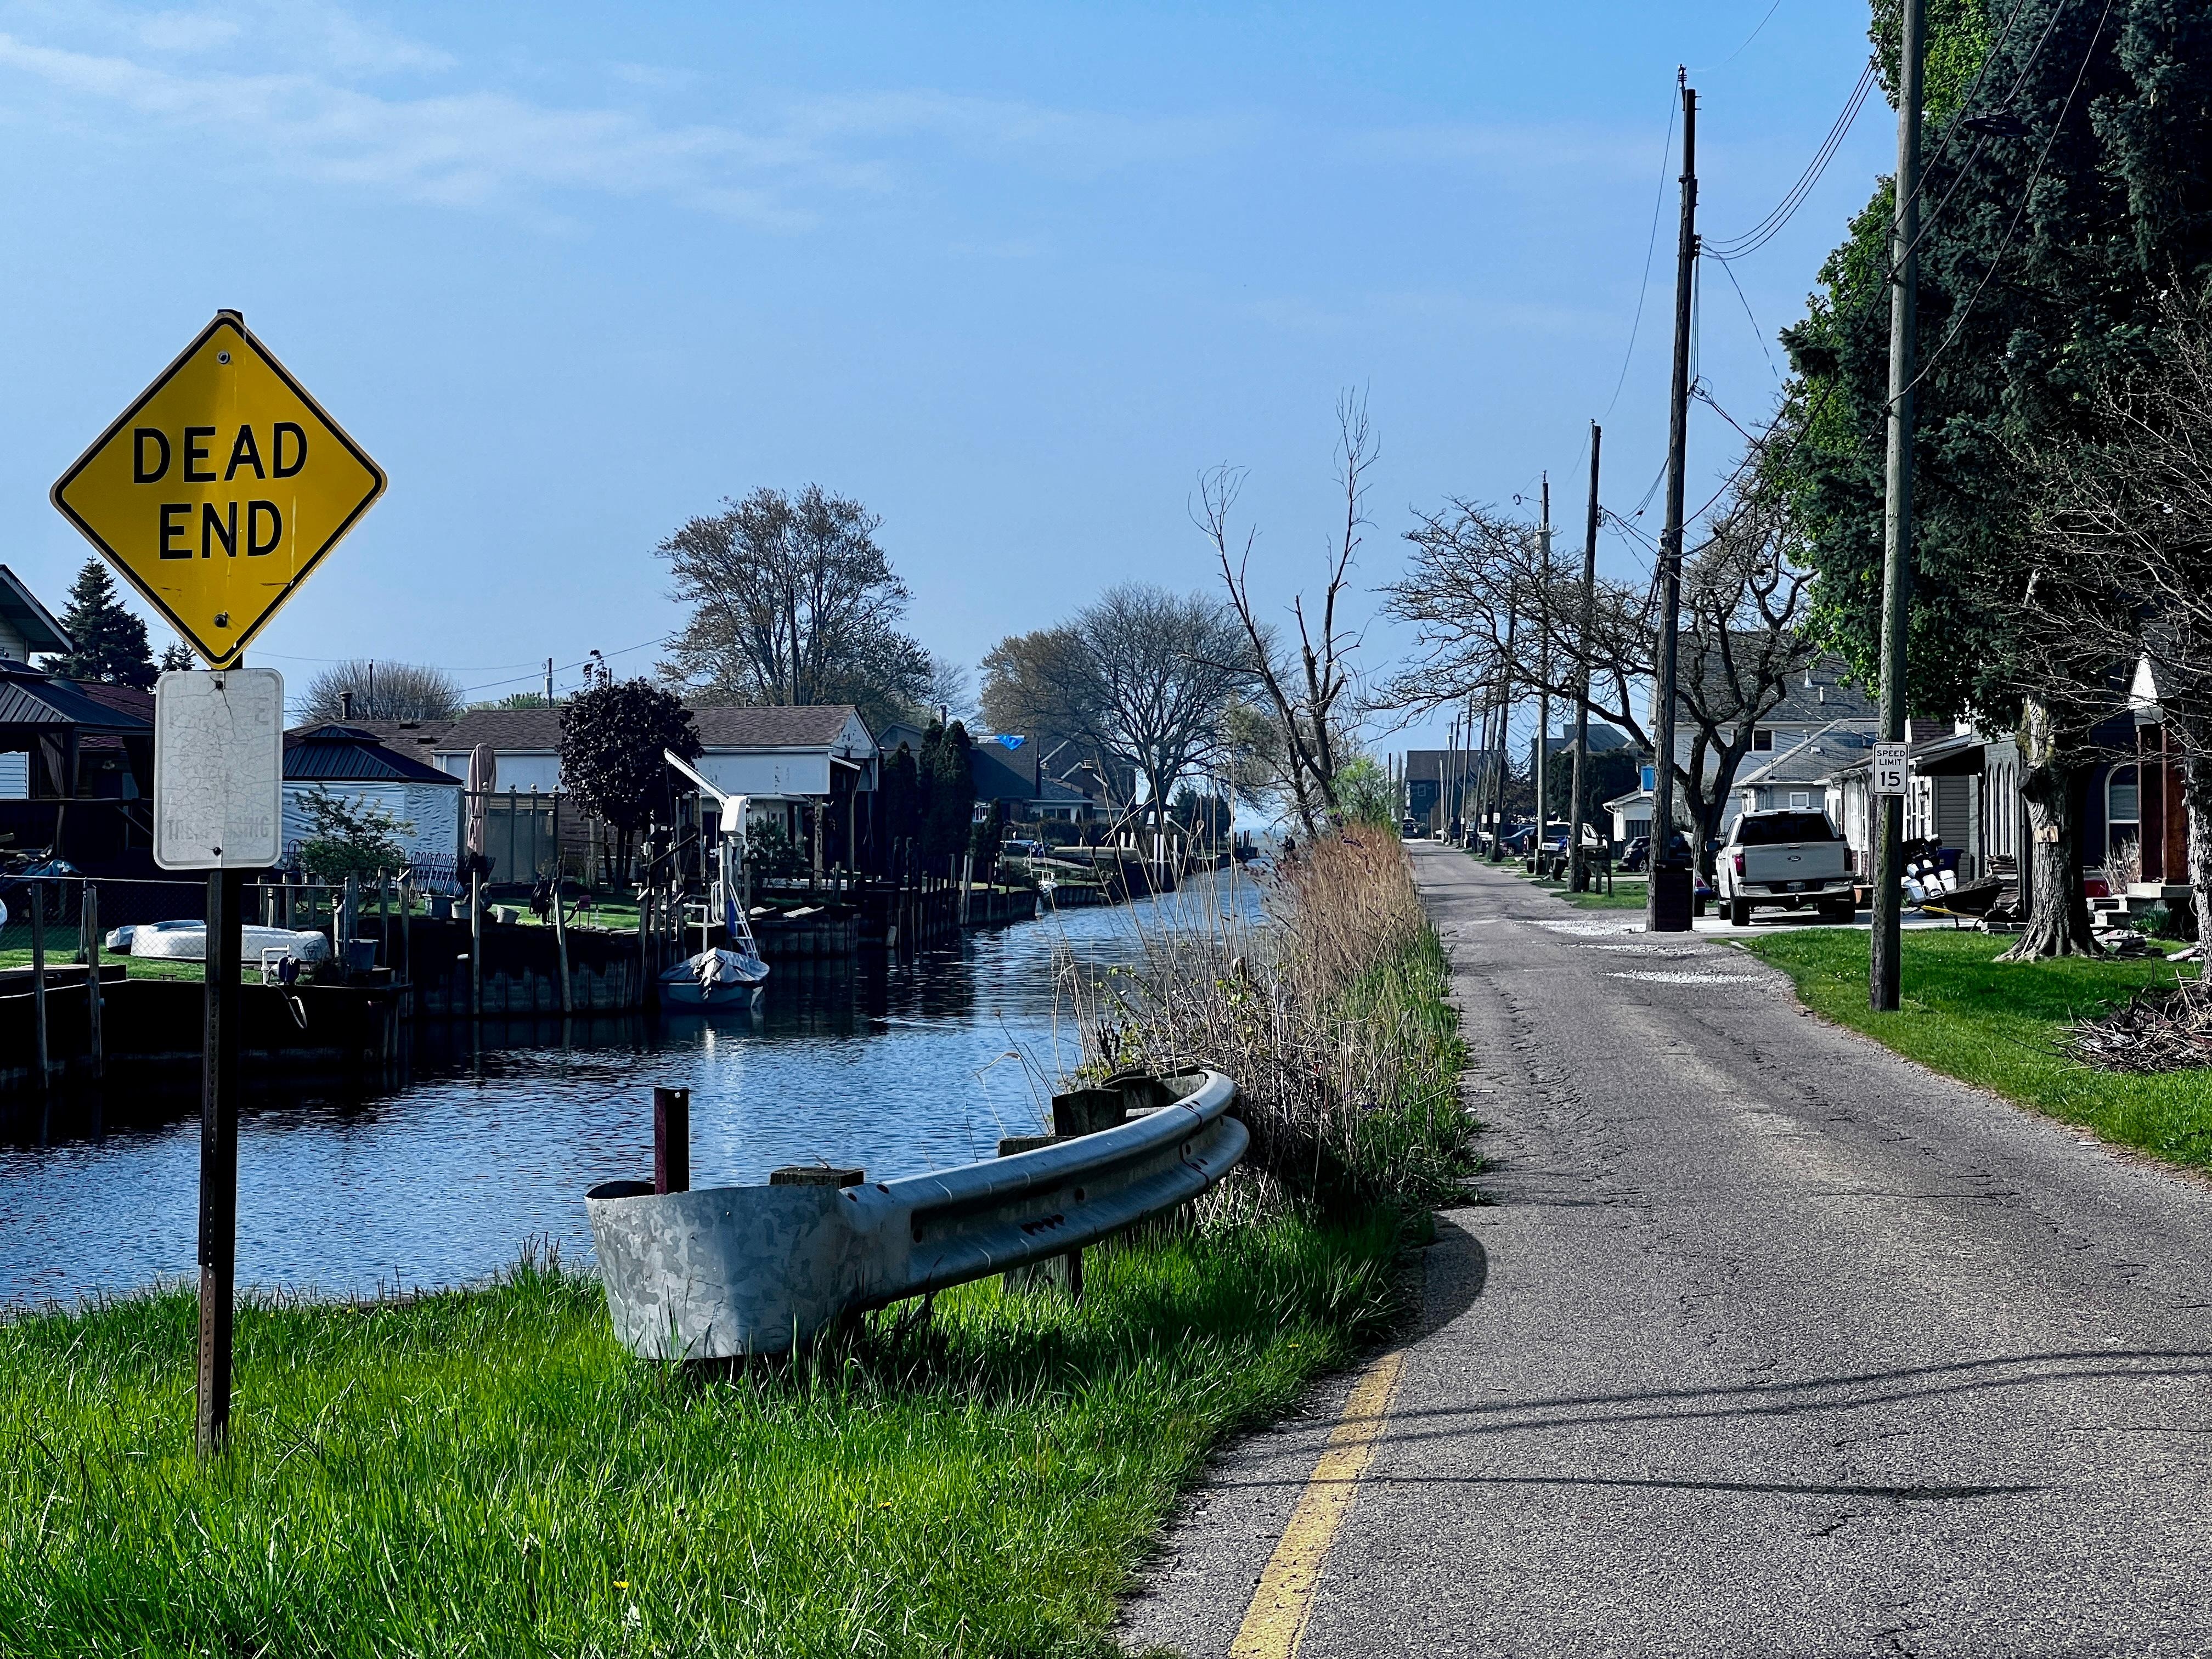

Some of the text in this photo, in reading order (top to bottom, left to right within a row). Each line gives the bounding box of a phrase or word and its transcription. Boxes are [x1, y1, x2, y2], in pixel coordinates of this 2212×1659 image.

[133, 422, 308, 484] DEAD
[159, 500, 283, 560] END
[1880, 771, 1900, 787] 15
